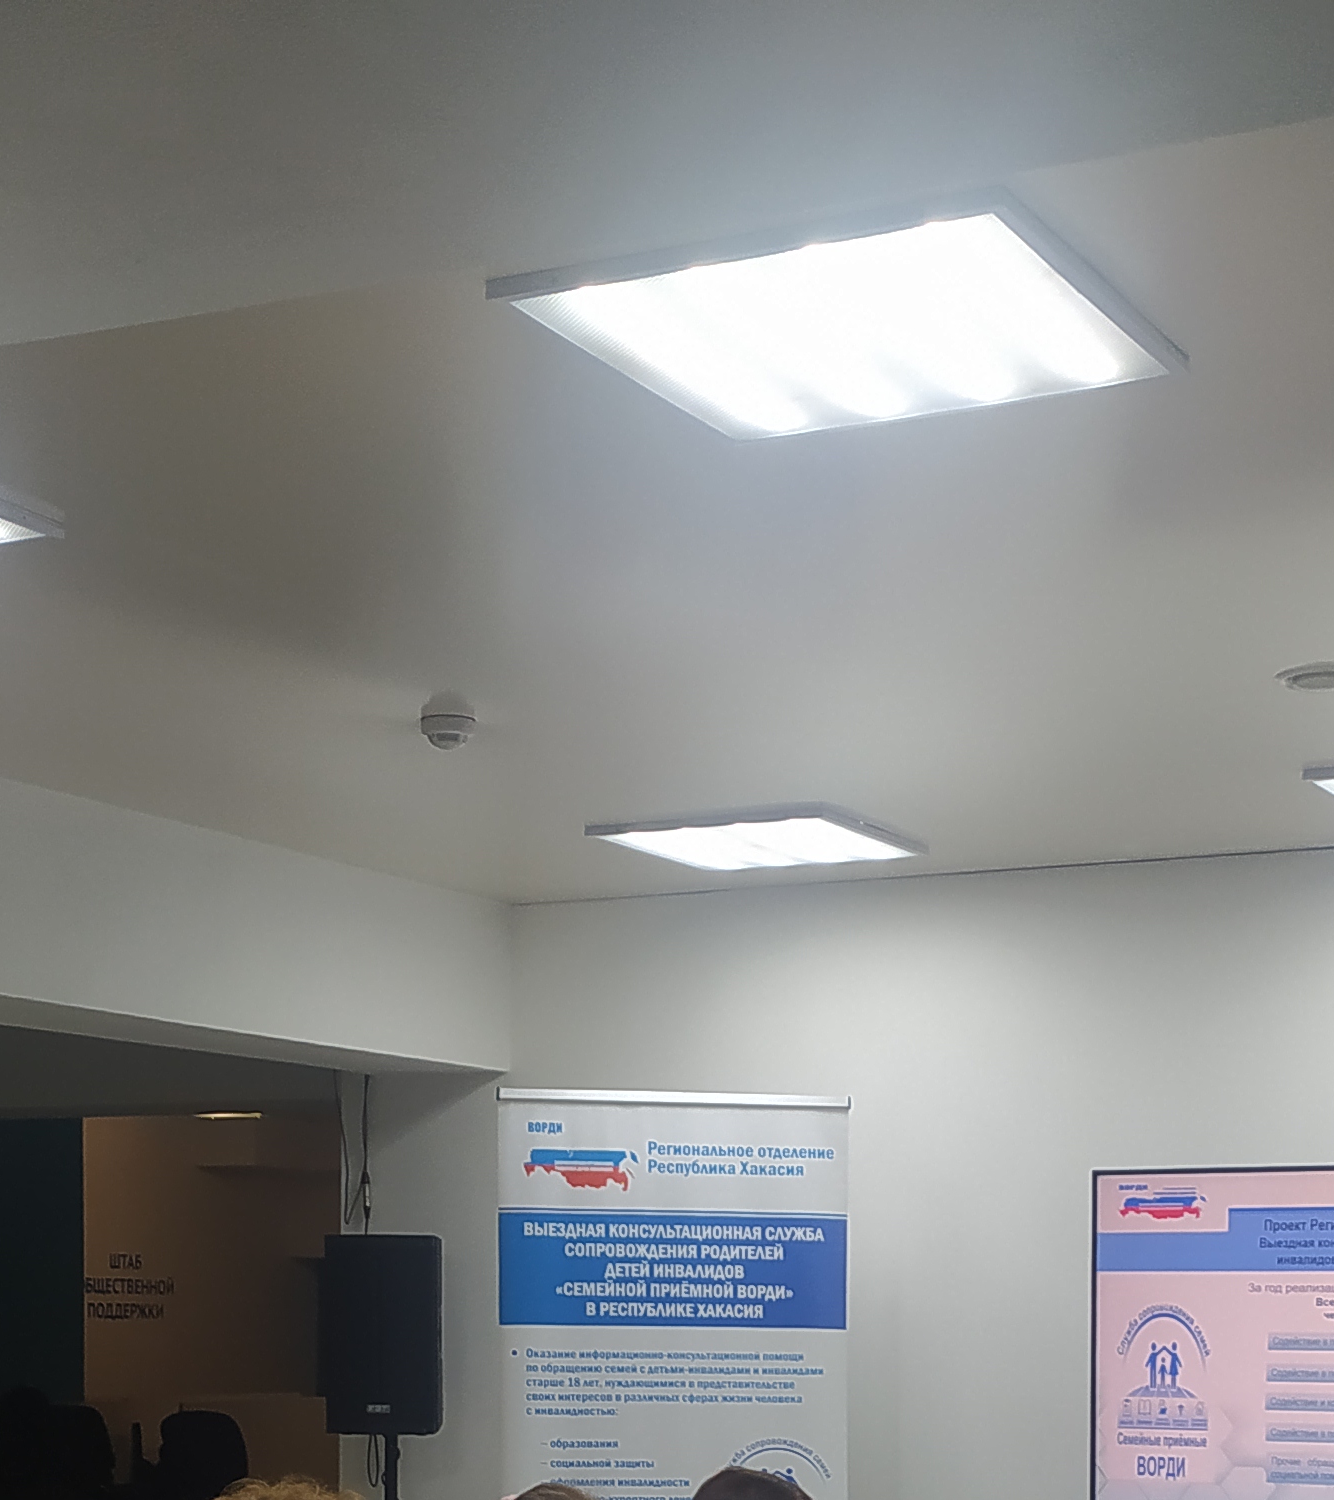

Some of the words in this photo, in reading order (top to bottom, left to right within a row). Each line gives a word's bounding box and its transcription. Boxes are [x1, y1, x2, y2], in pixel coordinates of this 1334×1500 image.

[527, 1121, 563, 1134] ВОРДИ
[647, 1141, 754, 1159] Региональное
[758, 1146, 834, 1160] отделение
[648, 1161, 736, 1176] Республика
[739, 1162, 804, 1177] Хакасия
[523, 1222, 605, 1239] ВЫЕЗДНАЯ
[609, 1224, 761, 1242] КОНСУЛЬТАЦИОННАЯ
[765, 1227, 824, 1242] СЛУЖБА
[1264, 1218, 1307, 1233] Проект
[1259, 1237, 1315, 1250] Выездная
[565, 1243, 697, 1261] СОПРОВОЖДЕНИЯ
[700, 1243, 784, 1262] РОДИТЕЛЕЙ
[109, 1253, 142, 1269] ШТАБ
[604, 1259, 650, 1281] ДЕТЕЙ
[653, 1264, 745, 1281] ИНВАЛИДОВ
[84, 1276, 175, 1295] БЩЕСТВЕННОЙ
[556, 1279, 647, 1297] «СЕМЕЙНОЙ
[650, 1280, 734, 1298] ПРИЁМНОЙ
[737, 1285, 793, 1302] ВОРДИ»
[1247, 1282, 1262, 1293] За
[1265, 1284, 1283, 1295] год
[1316, 1298, 1334, 1307] Все
[87, 1302, 164, 1320] ПОДДЕРЖКИ
[586, 1302, 596, 1317] В
[599, 1303, 695, 1318] РЕСПУБЛИКЕ
[696, 1303, 763, 1319] ХАКАСИЯ
[526, 1349, 577, 1360] Оказание
[579, 1349, 761, 1362] информационно-консультационной
[762, 1352, 804, 1363] помощи
[526, 1365, 538, 1374] по
[540, 1362, 603, 1375] обращению
[604, 1363, 637, 1374] семей
[640, 1366, 646, 1374] с
[647, 1366, 751, 1376] детьми-инвалидами
[752, 1367, 760, 1375] и
[762, 1367, 824, 1377] инвалидами
[526, 1378, 565, 1389] старше
[567, 1377, 580, 1388] 18
[604, 1379, 686, 1391] нуждающимися
[688, 1381, 695, 1389] в
[697, 1380, 795, 1391] представительстве
[526, 1393, 556, 1403] своих
[558, 1393, 613, 1404] интересов
[615, 1394, 622, 1403] в
[624, 1393, 680, 1404] различных
[681, 1393, 719, 1405] сферах
[721, 1395, 753, 1404] жизни
[755, 1395, 802, 1404] человека
[526, 1407, 533, 1415] с
[549, 1439, 619, 1450] образования
[1117, 1431, 1161, 1446] Семейные
[1163, 1433, 1207, 1449] приёмные
[550, 1458, 612, 1470] социальной
[613, 1459, 655, 1470] защиты
[1137, 1455, 1186, 1480] ВОРДИ
[617, 1478, 690, 1487] инвалидности
